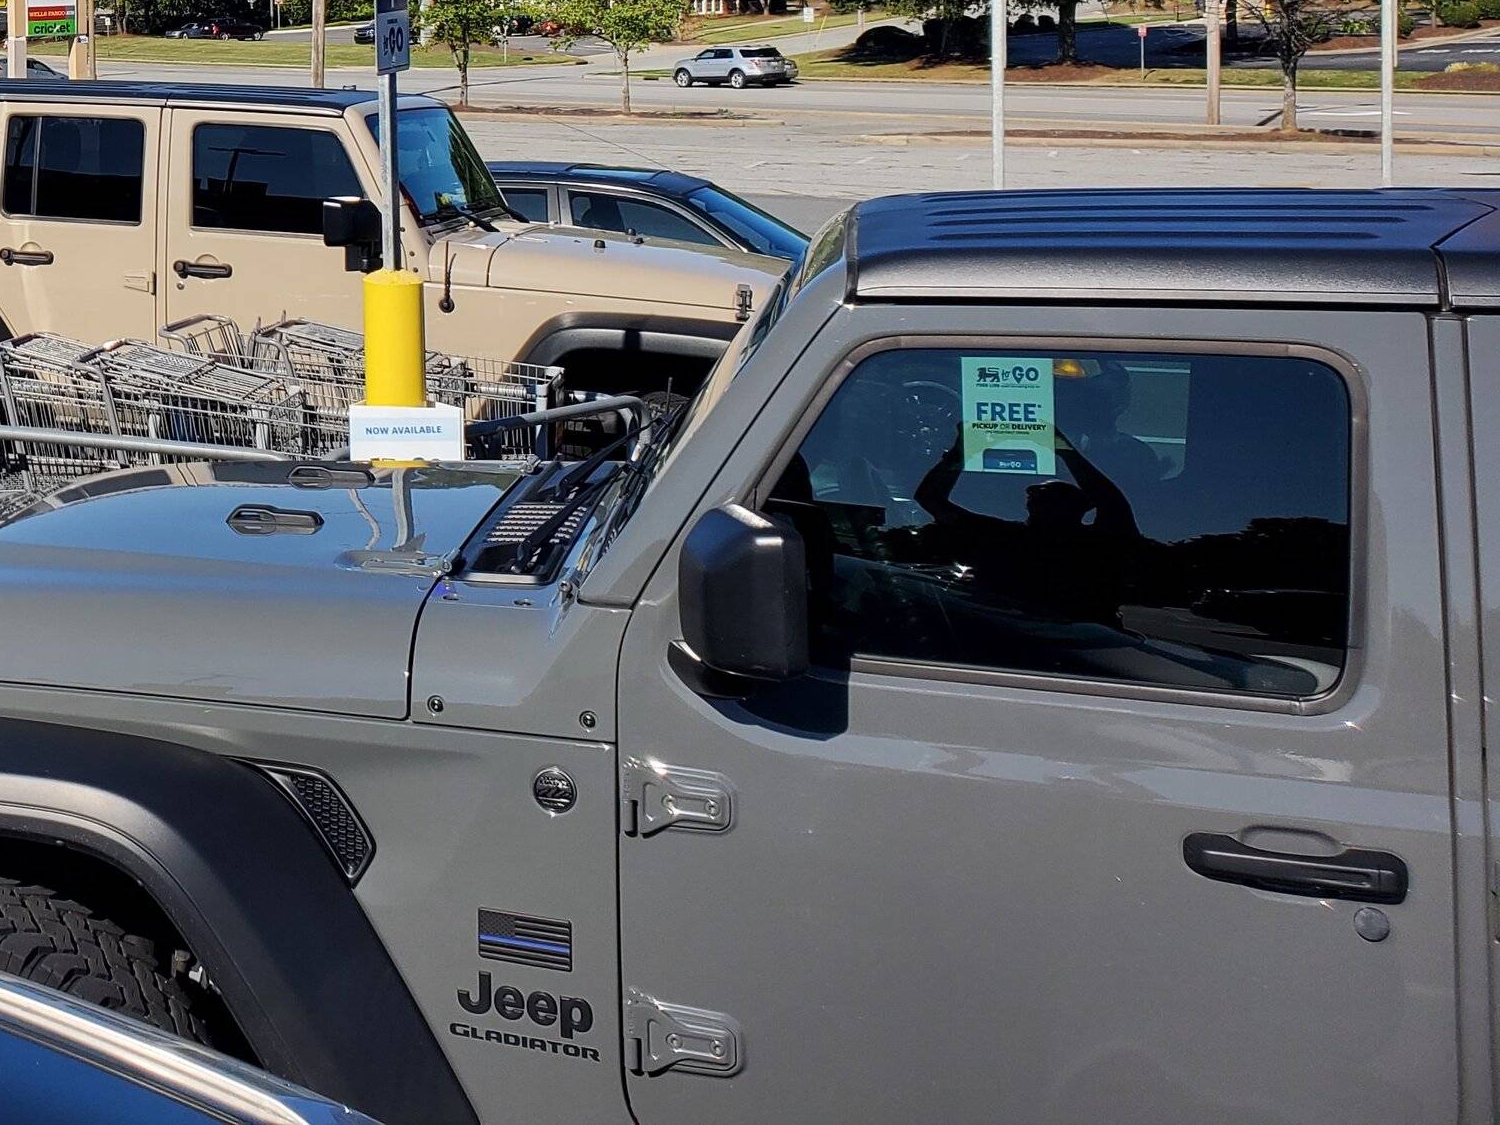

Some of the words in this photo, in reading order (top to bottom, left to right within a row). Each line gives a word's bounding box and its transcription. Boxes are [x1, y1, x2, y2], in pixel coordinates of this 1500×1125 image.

[33, 22, 71, 34] cricket
[388, 26, 404, 55] GO
[1012, 366, 1039, 384] GO
[365, 427, 389, 435] NOW
[392, 426, 442, 435] AVAILABLE
[457, 970, 594, 1040] Jeep
[449, 1022, 601, 1062] GLADIATOR
